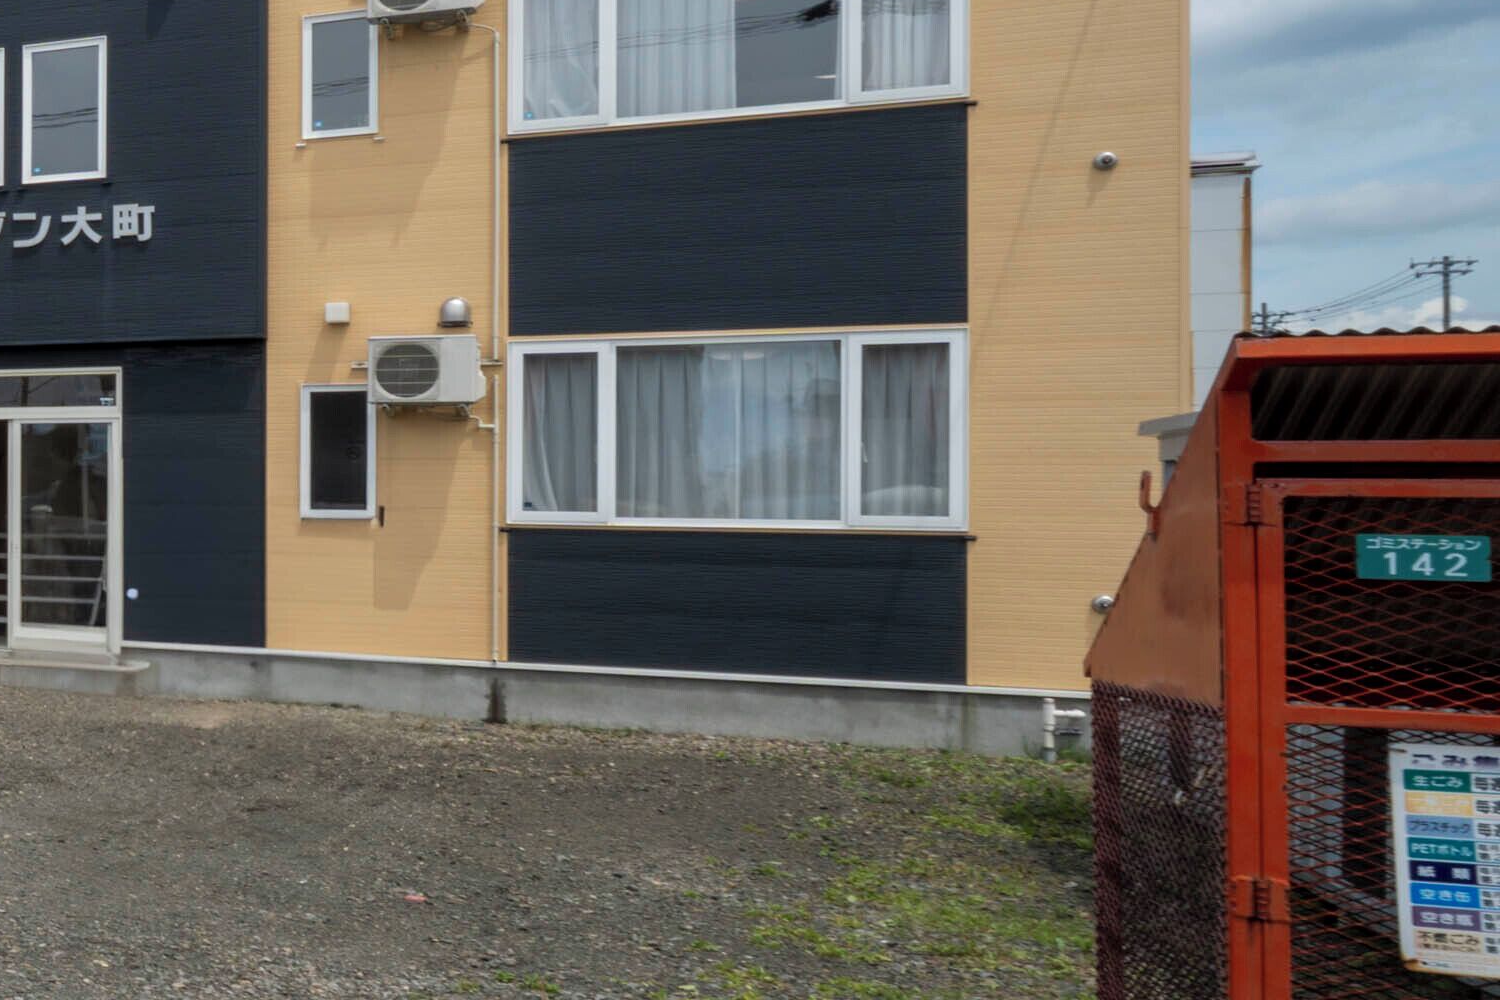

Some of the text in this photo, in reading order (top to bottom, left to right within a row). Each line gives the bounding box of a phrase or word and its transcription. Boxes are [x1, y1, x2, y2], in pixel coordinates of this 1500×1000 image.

[1366, 537, 1482, 550] ゴミステーション
[1383, 551, 1469, 577] 142
